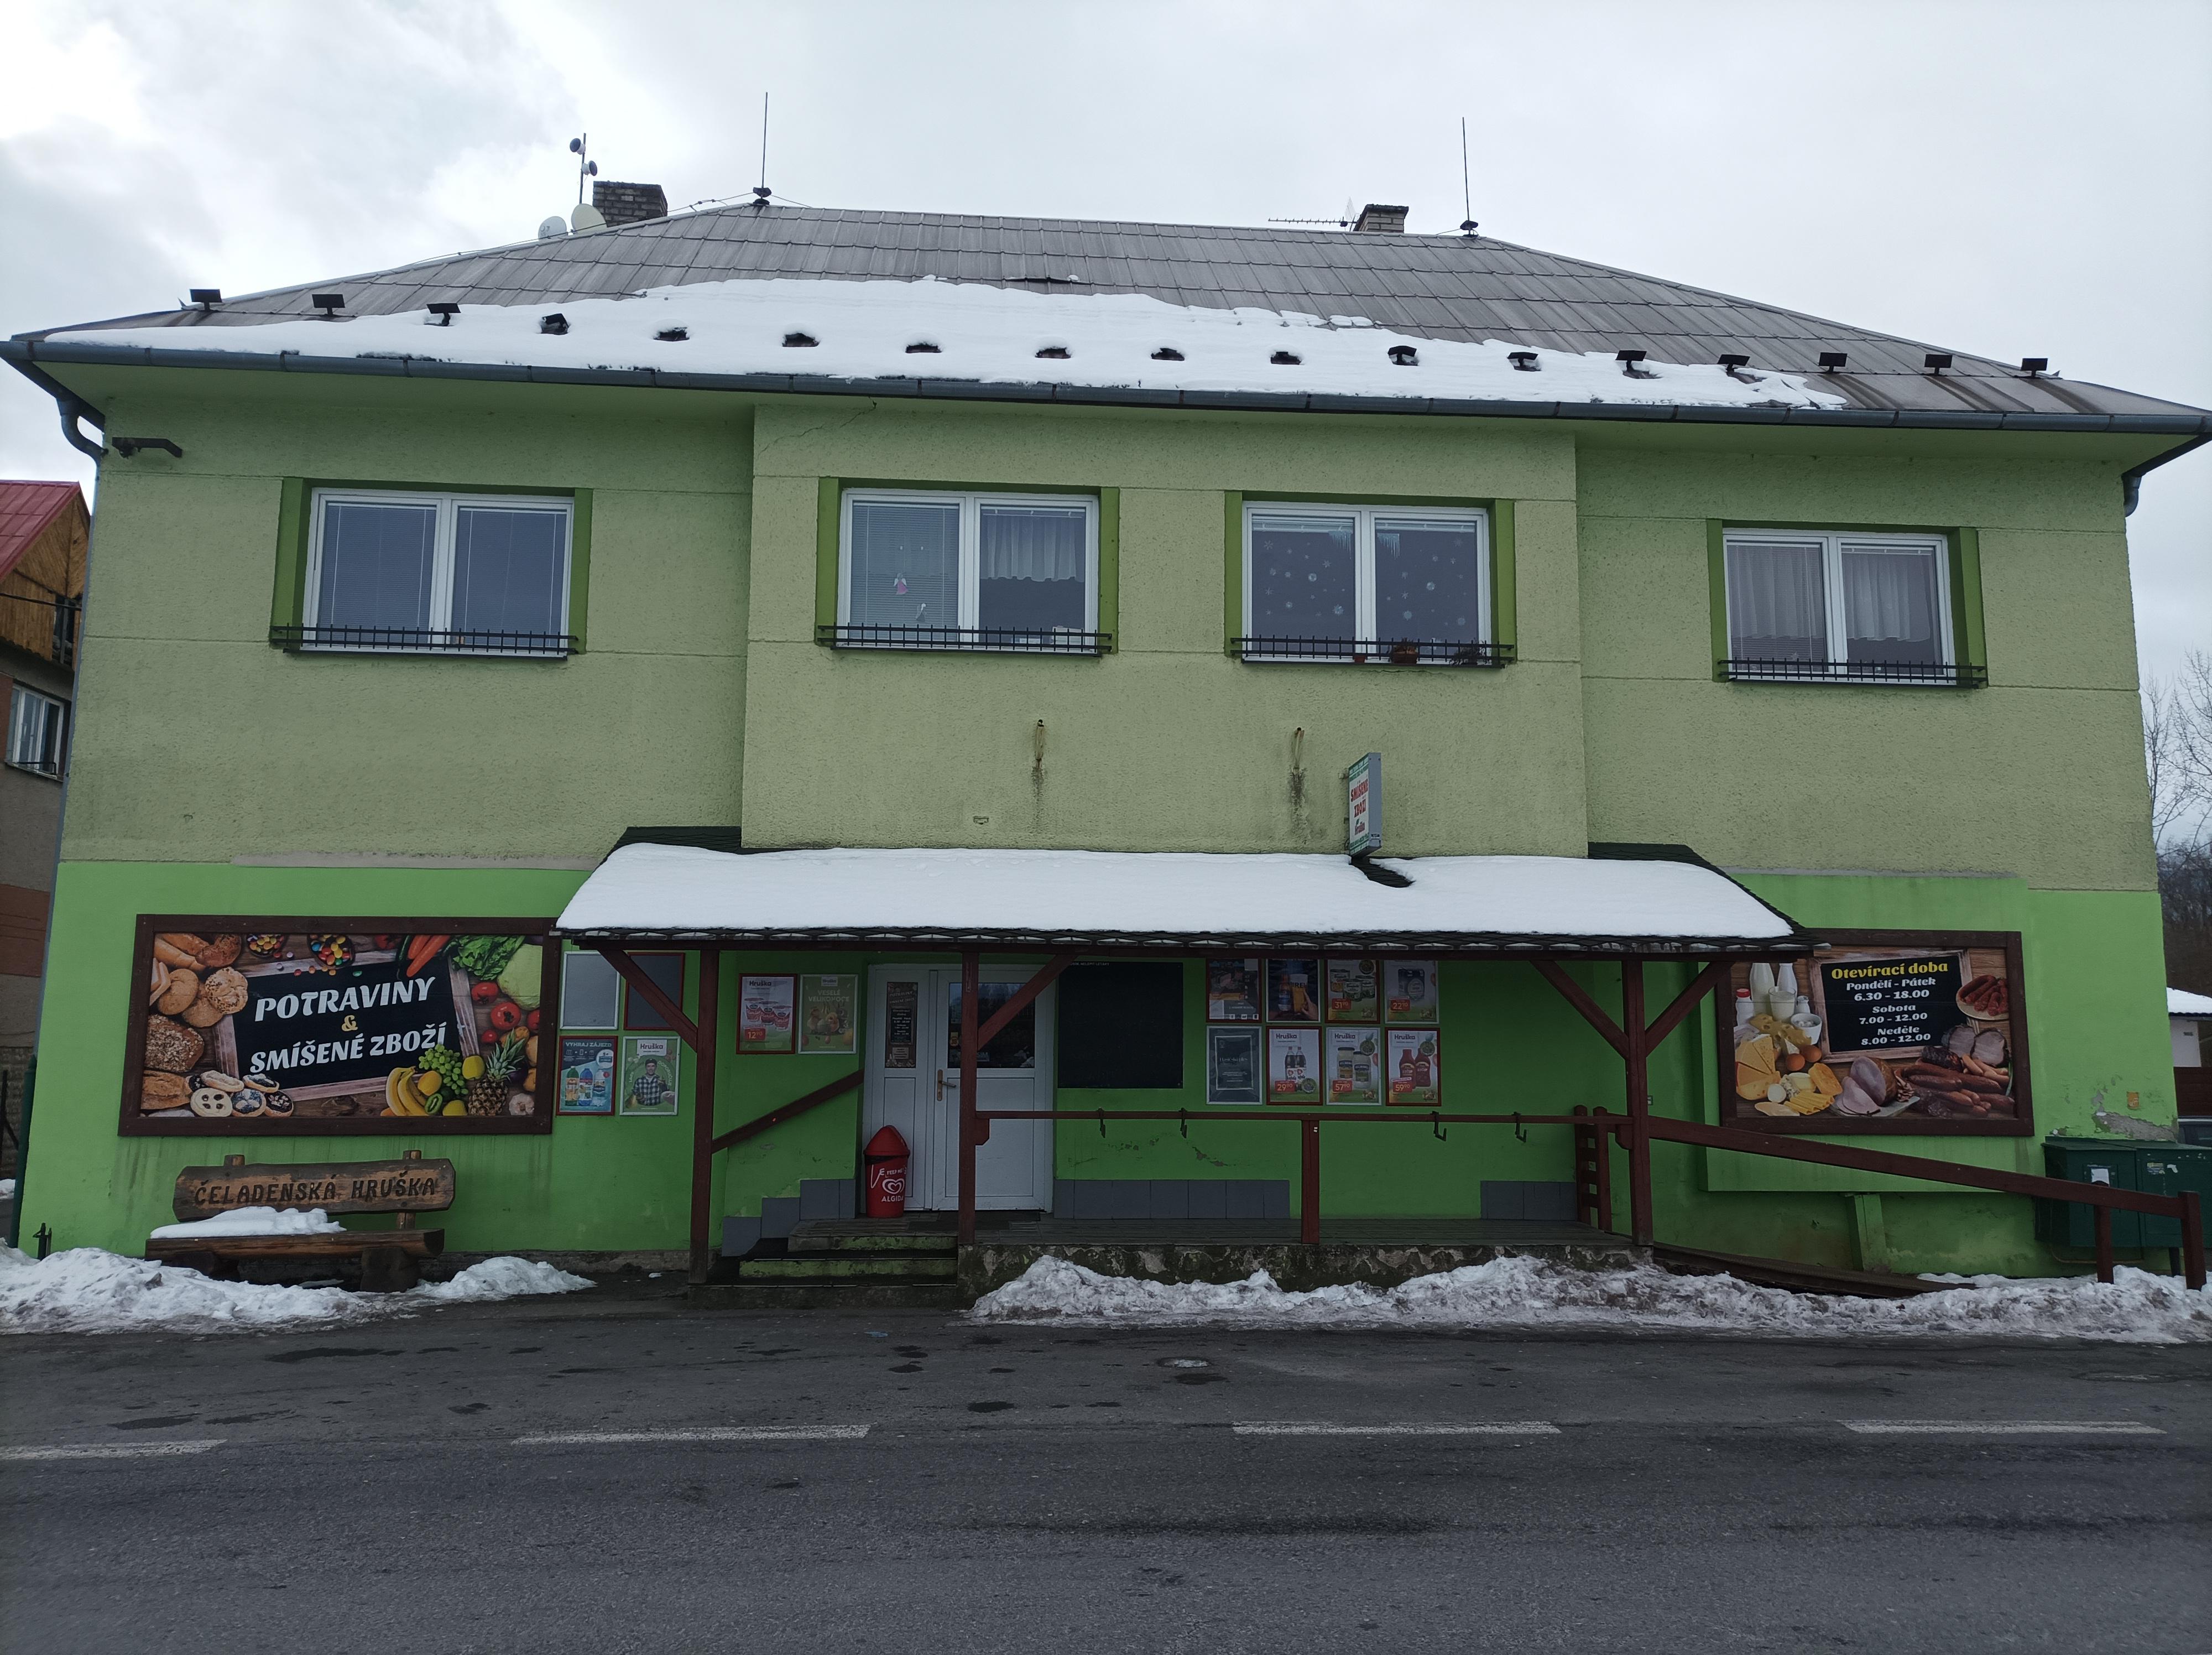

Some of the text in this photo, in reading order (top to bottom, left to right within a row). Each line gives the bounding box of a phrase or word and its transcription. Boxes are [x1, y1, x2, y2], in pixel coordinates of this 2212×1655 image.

[1831, 961, 1949, 979] Otevírací doba
[1846, 980, 1892, 991] Pondělí
[1901, 977, 1936, 987] Pátek
[254, 977, 436, 1022] POTRAVINY
[1854, 992, 1882, 1001] 6.30
[1893, 990, 1930, 999] 18.00
[1872, 1005, 1916, 1013] Sobota
[341, 1014, 358, 1032] &
[1859, 1016, 1884, 1024] 7.00
[1895, 1012, 1928, 1022] 12.00
[1877, 1026, 1920, 1035] Neděle
[1861, 1037, 1887, 1045] 8.00
[1897, 1033, 1931, 1043] 12.00
[249, 1021, 447, 1073] SMÍŠENÉ ZBOŽÍ
[194, 1170, 436, 1205] ČELADENSKÁ HRUŠKA
